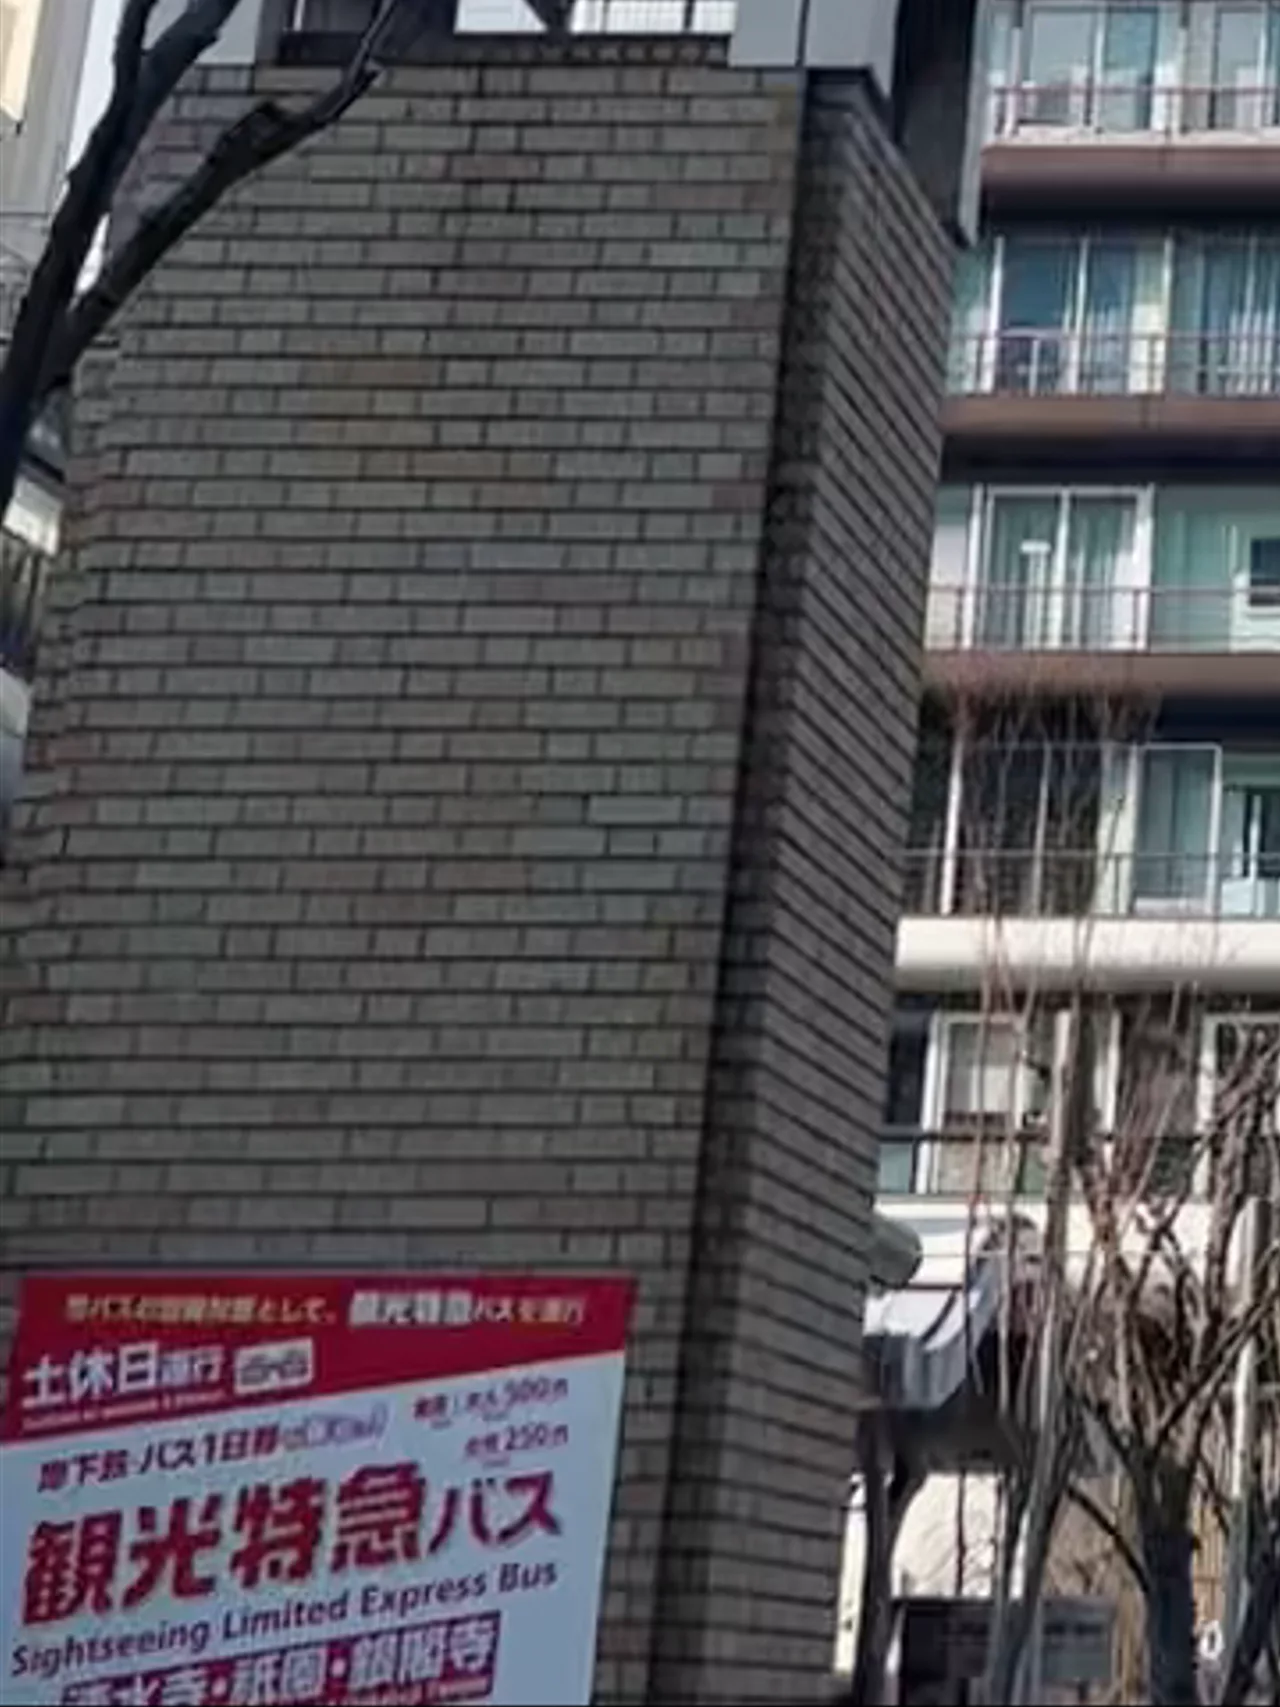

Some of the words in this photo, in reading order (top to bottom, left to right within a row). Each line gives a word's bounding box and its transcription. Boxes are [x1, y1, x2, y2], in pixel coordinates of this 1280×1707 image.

[21, 1461, 563, 1626] 観光特急バス
[11, 1619, 210, 1677] Sightseeing
[222, 1589, 348, 1641] Limited
[360, 1573, 487, 1619] Express
[498, 1562, 558, 1594] Bus
